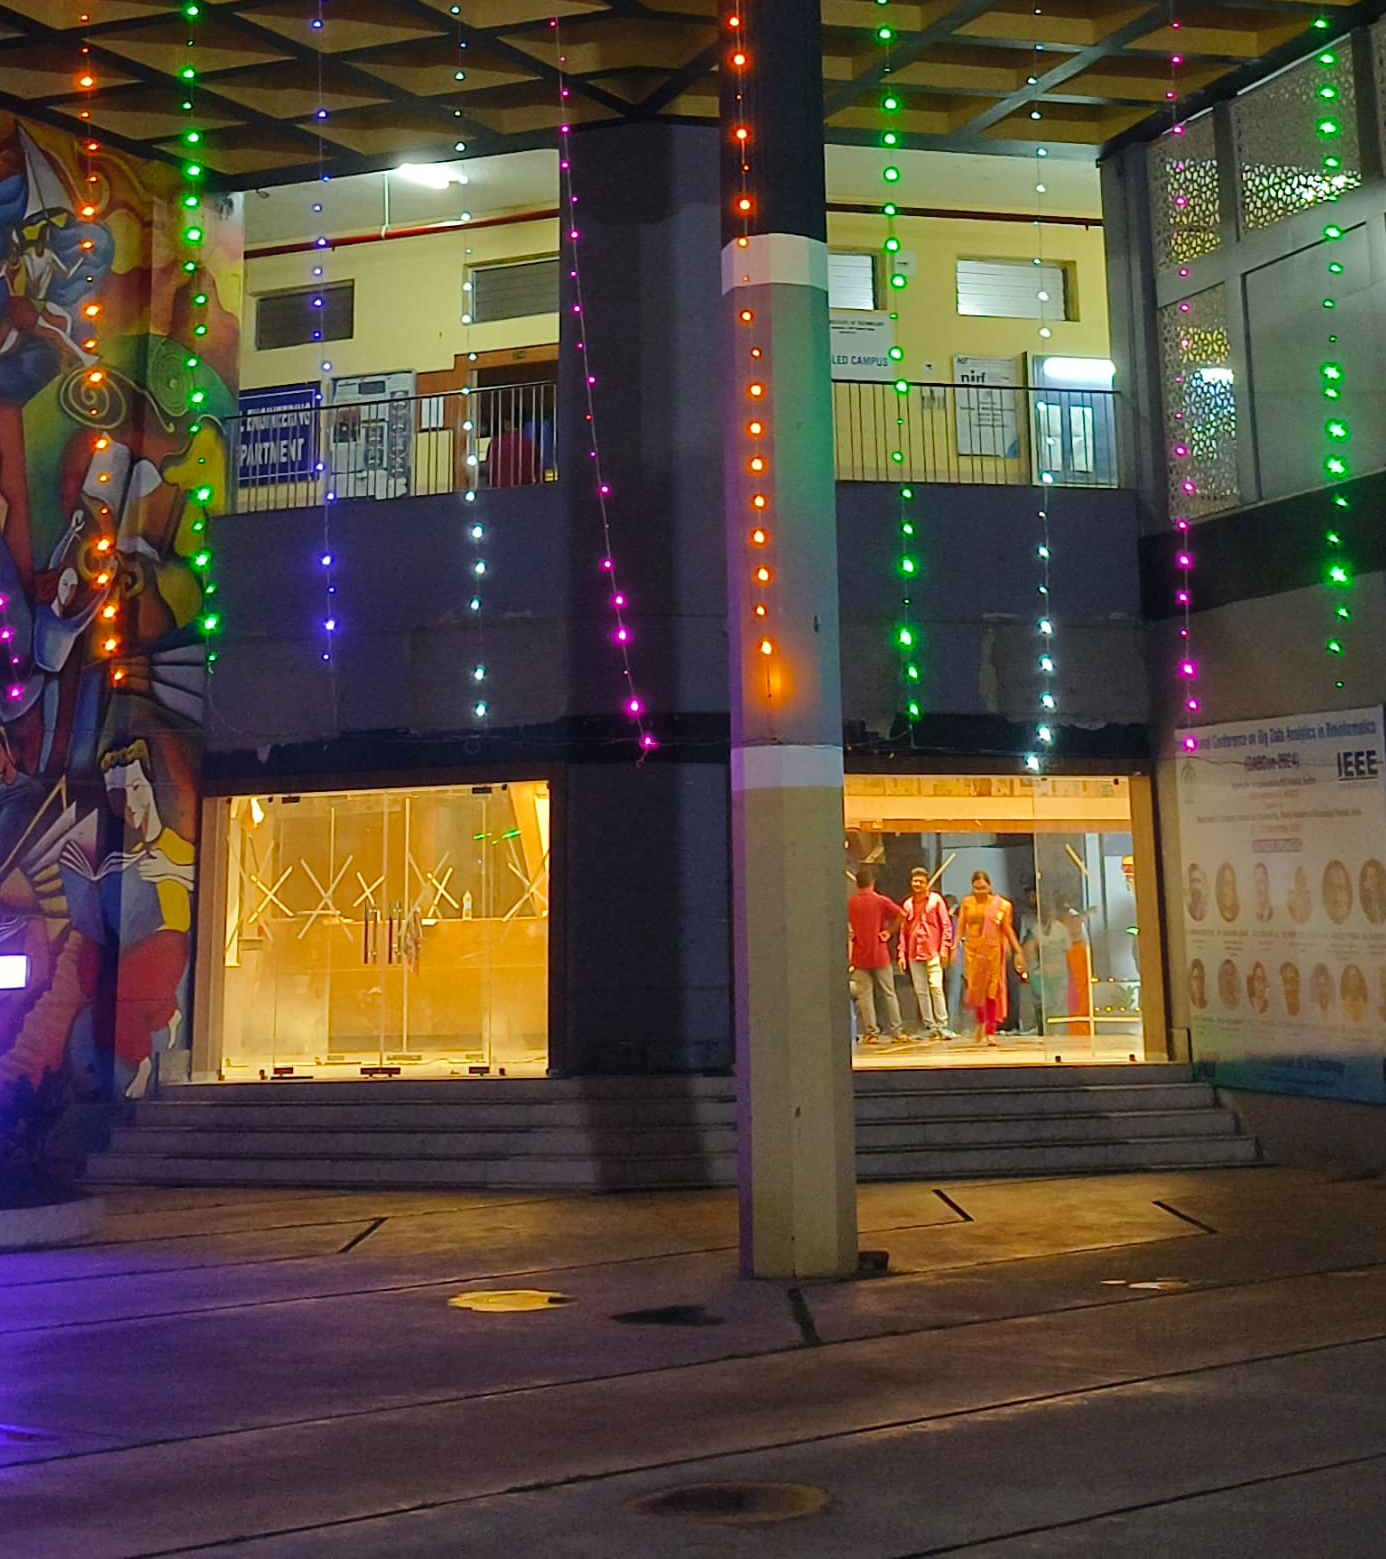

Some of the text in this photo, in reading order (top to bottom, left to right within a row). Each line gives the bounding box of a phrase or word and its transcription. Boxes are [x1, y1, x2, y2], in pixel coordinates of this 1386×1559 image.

[851, 355, 889, 367] CAMPUS
[960, 369, 987, 384] nirf
[1337, 750, 1379, 777] IEEE
